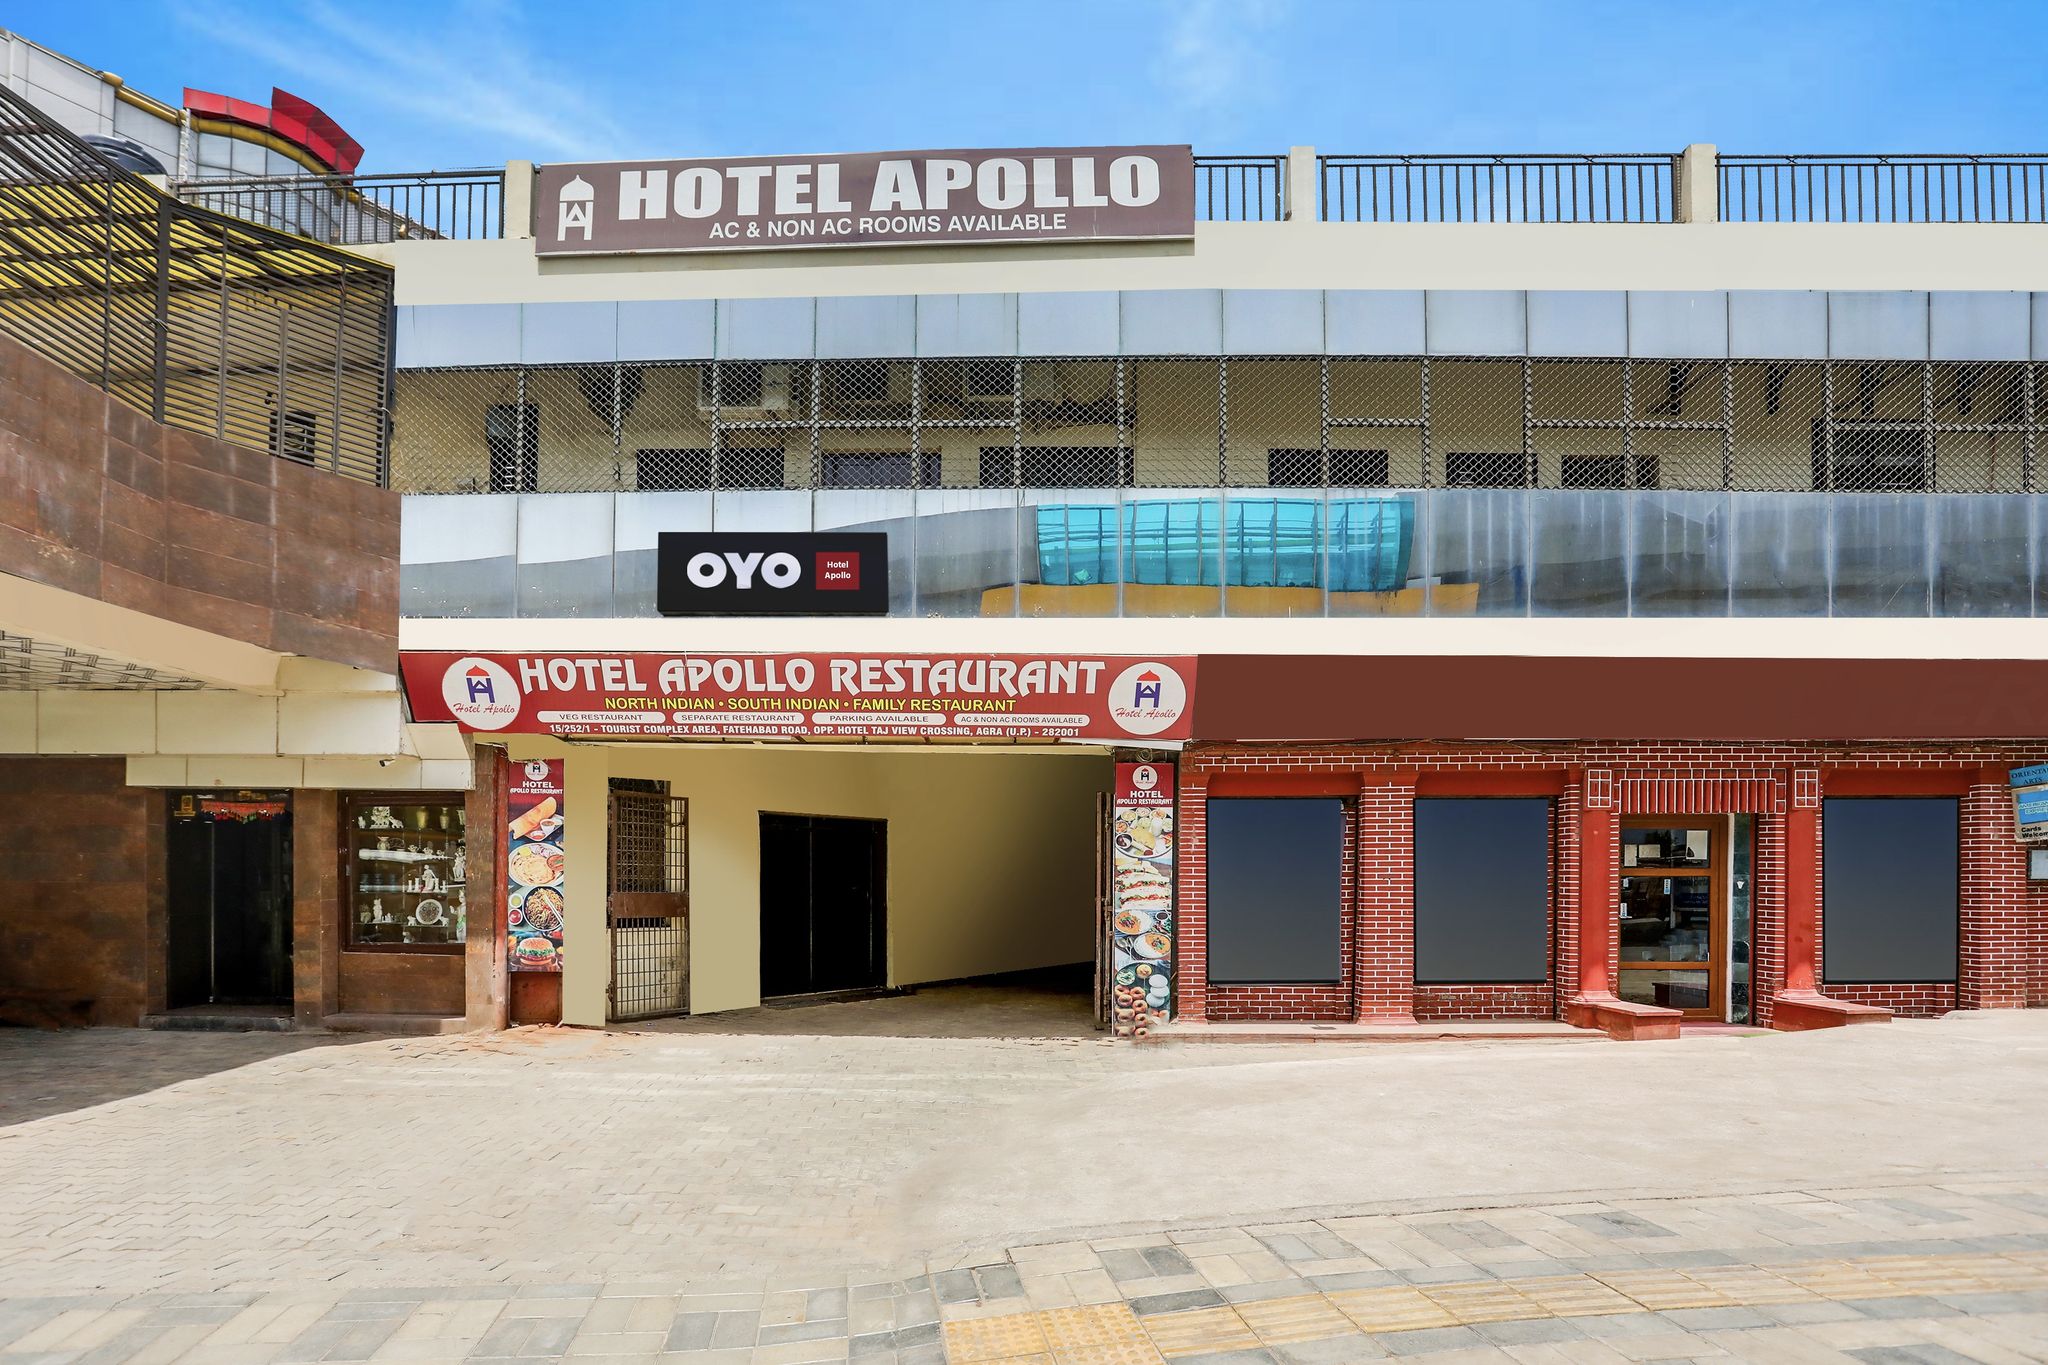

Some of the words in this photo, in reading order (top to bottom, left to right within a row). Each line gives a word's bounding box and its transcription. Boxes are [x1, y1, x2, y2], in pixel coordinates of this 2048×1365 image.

[619, 163, 852, 220] HOTEL
[869, 155, 1160, 211] APOLLO
[709, 222, 740, 239] AC
[746, 221, 761, 238] &
[768, 219, 815, 238] NON
[821, 217, 852, 235] AC
[860, 215, 941, 234] ROOMS
[948, 213, 1067, 232] AVAILABLE
[687, 552, 801, 589] OYO
[827, 560, 849, 569] Hotel
[824, 571, 851, 580] Apollo
[518, 658, 648, 695] HOTEL
[658, 658, 815, 696] APOLLO
[829, 659, 1106, 698] RESTAURANT
[453, 703, 480, 713] Hotel
[483, 704, 515, 715] Apollo
[605, 697, 657, 710] NORTH
[661, 698, 715, 710] INDIAN
[728, 698, 782, 711] SOUTH
[785, 698, 839, 711] INDIAN
[853, 698, 907, 711] FAMILY
[910, 699, 1016, 712] RESTAURANT
[732, 714, 796, 722] RESTAURANT
[1115, 707, 1142, 718] Hotel
[1144, 709, 1176, 720] Apollo
[550, 724, 591, 733] 15/252/1
[601, 724, 642, 734] TOURIST
[644, 725, 690, 734] COMPLEX
[692, 725, 721, 735] AREA,
[723, 725, 779, 735] FATEHABAD
[781, 725, 811, 736] ROAD,
[813, 726, 834, 735] OPP.
[837, 726, 869, 735] HOTEL
[871, 726, 889, 735] TAJ
[891, 726, 918, 735] VIEW
[920, 726, 973, 737] CROSSING,
[976, 727, 1002, 736] AGRA
[1005, 727, 1031, 737] (U.P.)
[1042, 727, 1079, 737] 282001
[1130, 790, 1163, 798] HOTEL
